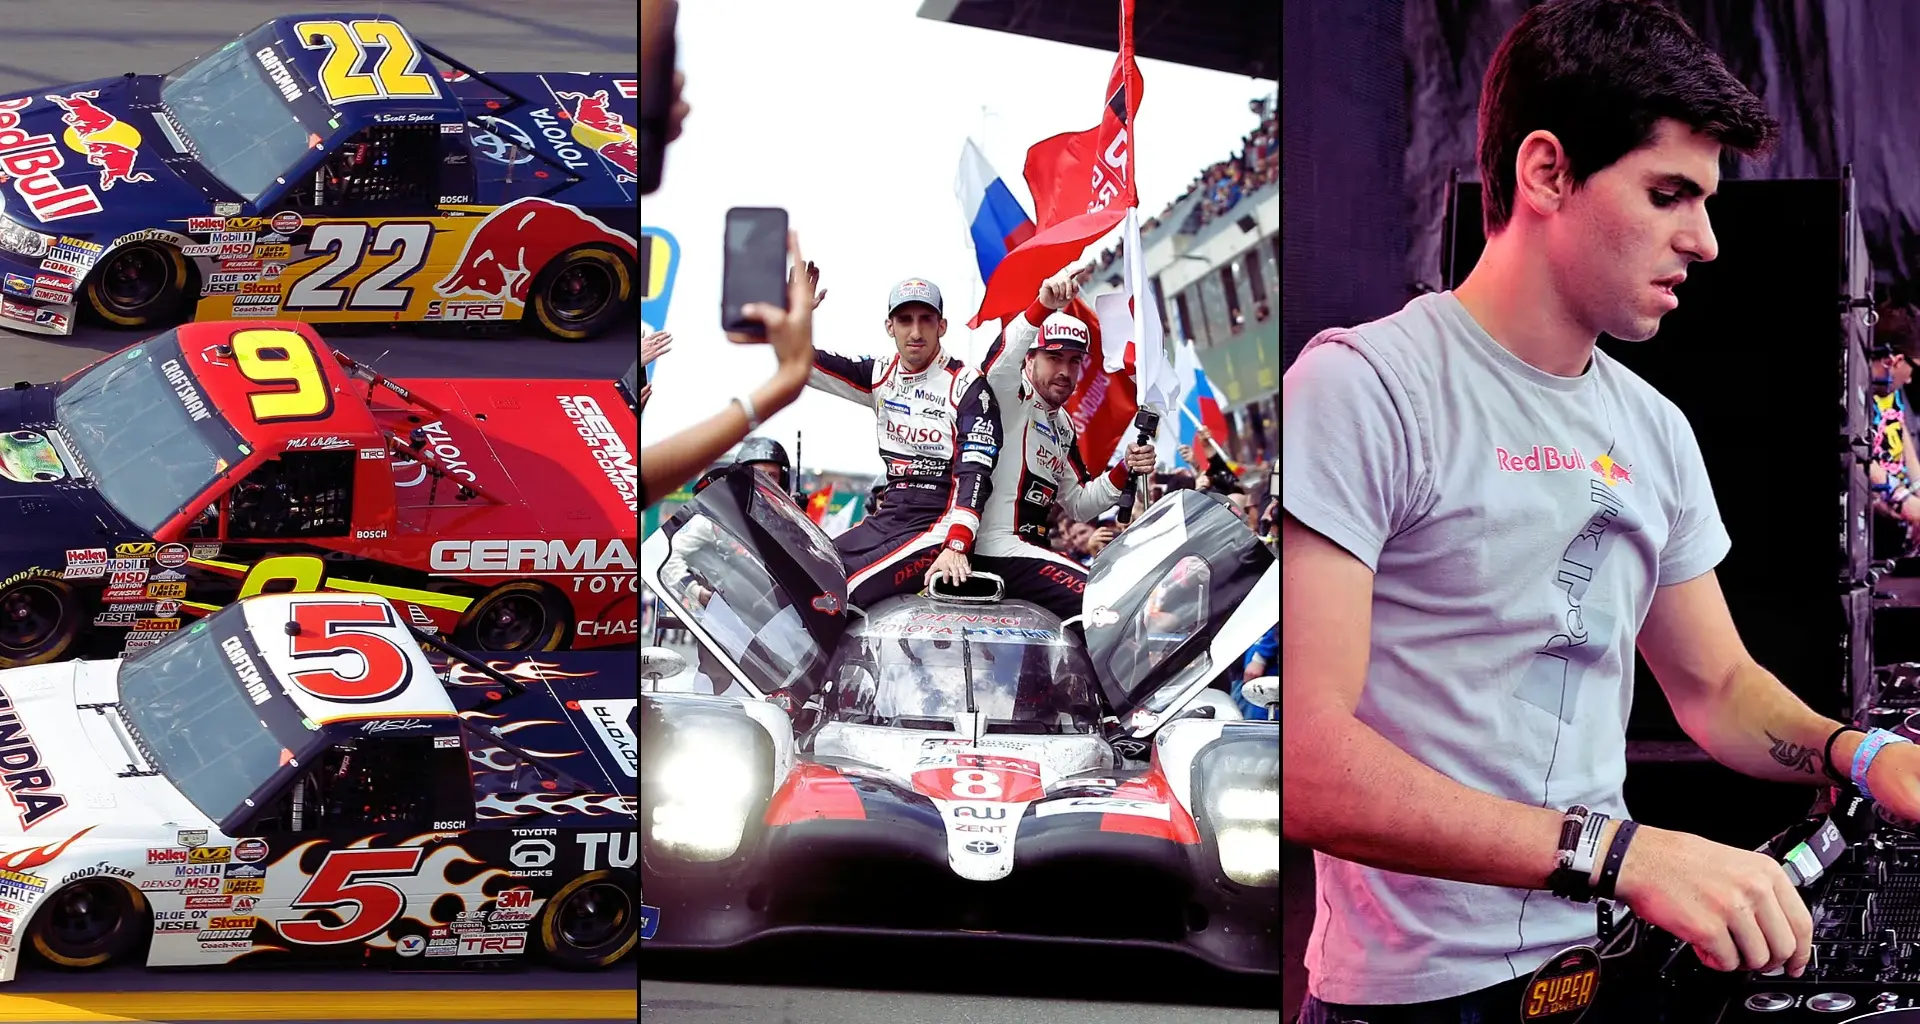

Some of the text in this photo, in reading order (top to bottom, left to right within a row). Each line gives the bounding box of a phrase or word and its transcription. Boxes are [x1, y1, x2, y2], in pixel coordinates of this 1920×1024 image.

[294, 20, 442, 105] 22
[256, 46, 302, 102] CRAFTSMAN
[529, 108, 588, 169] TOYOTA
[3, 148, 98, 219] Bull
[190, 219, 225, 231] Holley
[60, 236, 104, 252] MOOG
[114, 232, 179, 246] GOOD YEAR
[212, 233, 240, 242] Mobil
[183, 244, 251, 254] DENSO MSD
[50, 248, 95, 267] MAHLE
[284, 221, 434, 311] 22
[202, 283, 282, 293] JESEL Stant
[35, 290, 69, 302] SIMPSON
[233, 296, 280, 304] MOROSO
[447, 305, 503, 319] TRD
[228, 326, 336, 425] 9
[161, 359, 205, 422] CRAFTSMAN
[383, 379, 409, 398] TUNDRA
[915, 389, 941, 405] Mobil
[886, 420, 942, 443] DENSO
[421, 420, 477, 489] OYOTA
[556, 395, 637, 518] MOTOR COMPAN
[1496, 445, 1586, 471] Red Bull
[356, 530, 387, 539] BOSCH
[67, 550, 106, 564] Holley
[66, 567, 103, 576] DENSO
[106, 560, 137, 570] Mobil
[0, 571, 27, 589] GOOD
[113, 572, 147, 582] MSD
[109, 603, 155, 611] FEATHERLITE
[94, 613, 137, 622] JESEL
[134, 619, 178, 630] Stant
[912, 613, 1020, 627] DENSO
[875, 623, 953, 635] TOYOTA
[288, 602, 413, 704] 5
[221, 635, 272, 706] CRAFTSMAN
[961, 757, 1037, 773] TOTAL
[951, 769, 1003, 799] 8
[434, 820, 466, 830] BOSCH
[512, 828, 557, 836] TOYOTA
[955, 824, 1006, 833] ZENT
[148, 849, 187, 862] Holley
[62, 865, 135, 884] GOOD YEAR
[175, 865, 208, 875] Mobil
[141, 878, 220, 888] DENSO MSD
[0, 885, 35, 904] AHLE
[276, 847, 424, 945] 5
[497, 891, 532, 908] 3M
[155, 911, 186, 920] BLUE
[209, 917, 256, 928] Stant
[156, 921, 200, 931] JESEL
[198, 930, 252, 939] MOROSO
[461, 937, 525, 953] TRD
[1529, 971, 1595, 1015] SUPER
